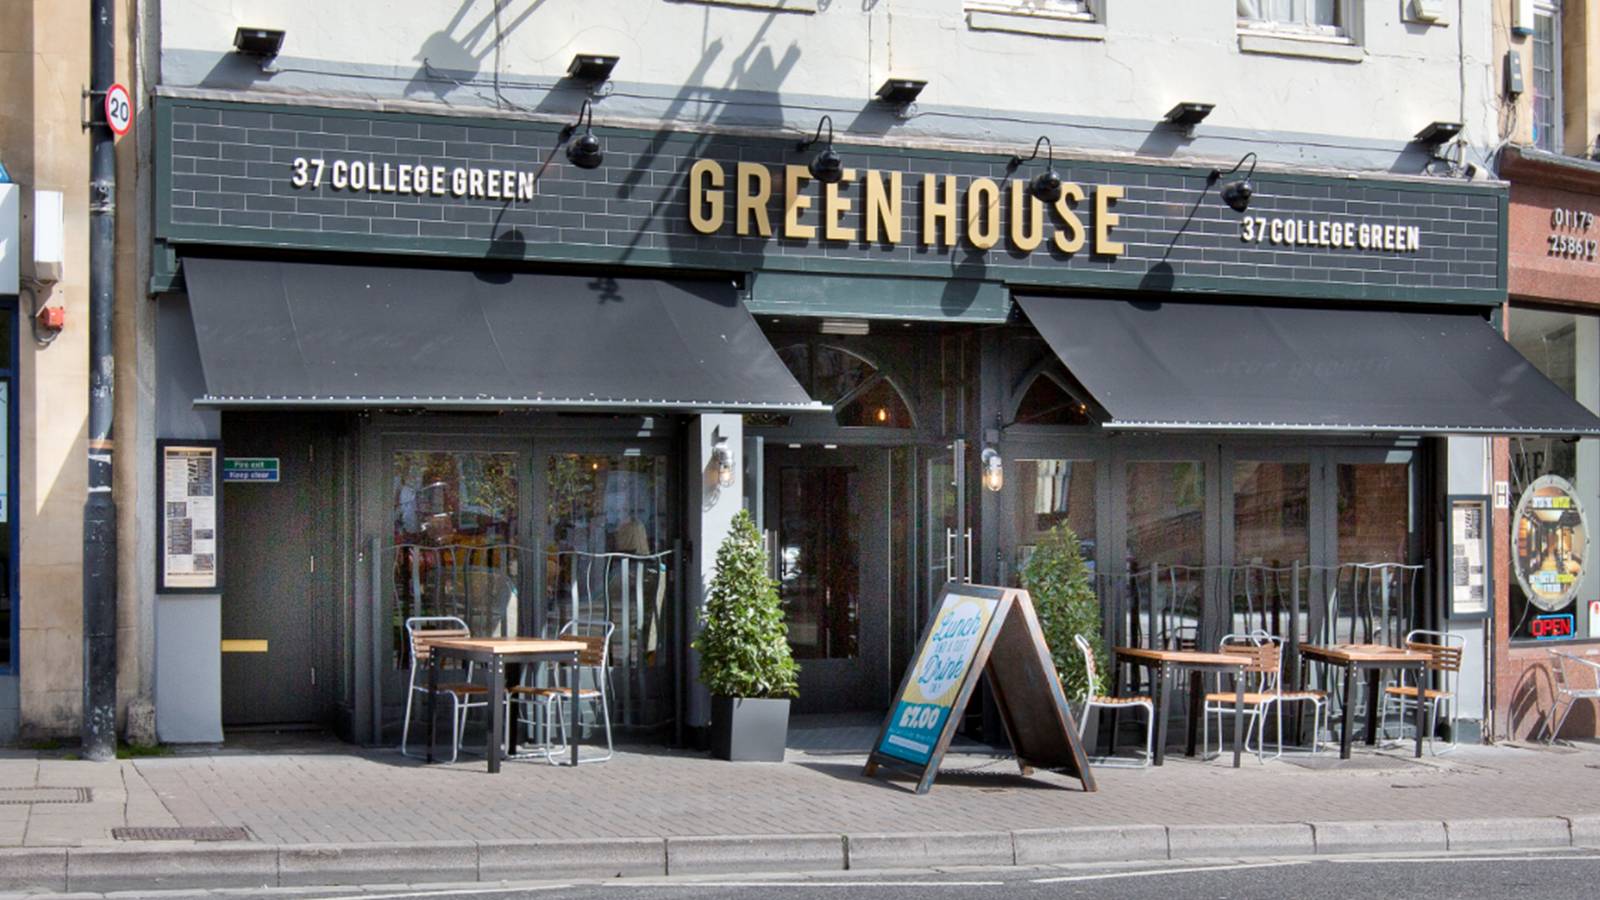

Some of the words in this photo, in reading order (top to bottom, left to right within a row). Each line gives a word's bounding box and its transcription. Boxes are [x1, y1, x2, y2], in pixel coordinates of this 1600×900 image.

[111, 97, 129, 122] 20
[292, 157, 325, 188] 37
[333, 160, 446, 195] COLLEGE
[454, 167, 536, 200] GREEN
[688, 159, 902, 244] GREEN
[923, 173, 1125, 256] HOUSE
[1242, 215, 1267, 242] 37
[1271, 218, 1356, 247] COLLEGE
[1358, 223, 1420, 250] GREEN
[1551, 235, 1599, 256] 258612
[932, 609, 981, 642] Lunch
[1531, 618, 1570, 637] OPEN
[919, 653, 963, 683] Drink
[899, 706, 940, 730] £7.00
